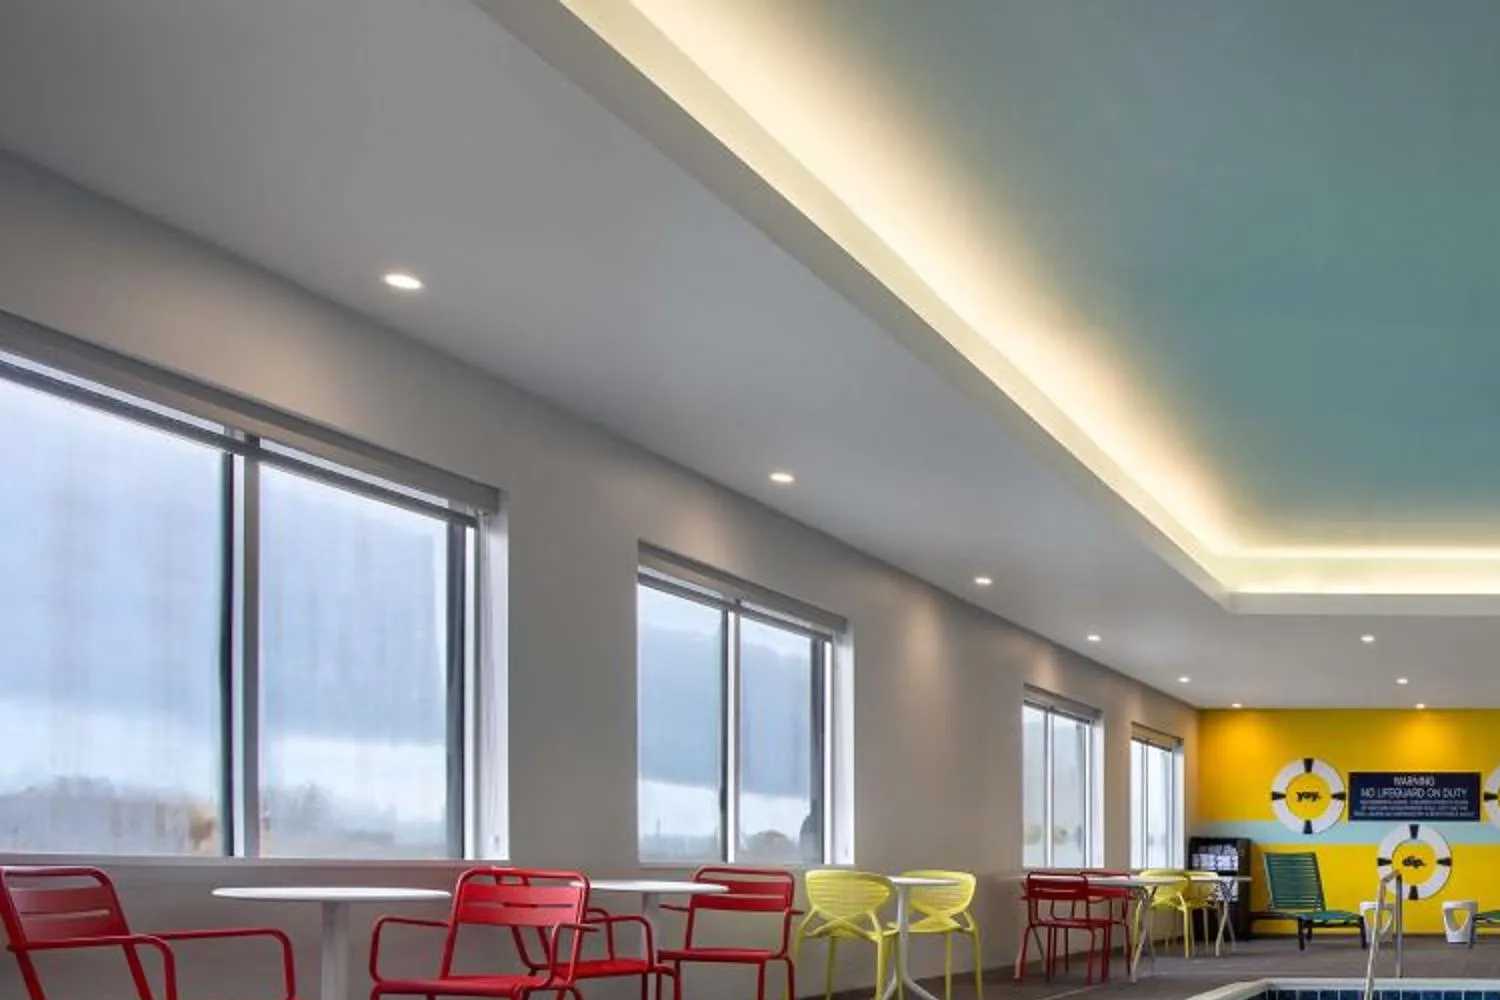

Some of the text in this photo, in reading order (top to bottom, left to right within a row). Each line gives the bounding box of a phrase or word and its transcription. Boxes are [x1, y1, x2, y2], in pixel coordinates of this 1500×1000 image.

[1393, 775, 1435, 786] WARNING
[1361, 787, 1468, 798] NO LIFEGUARD ON DUTY
